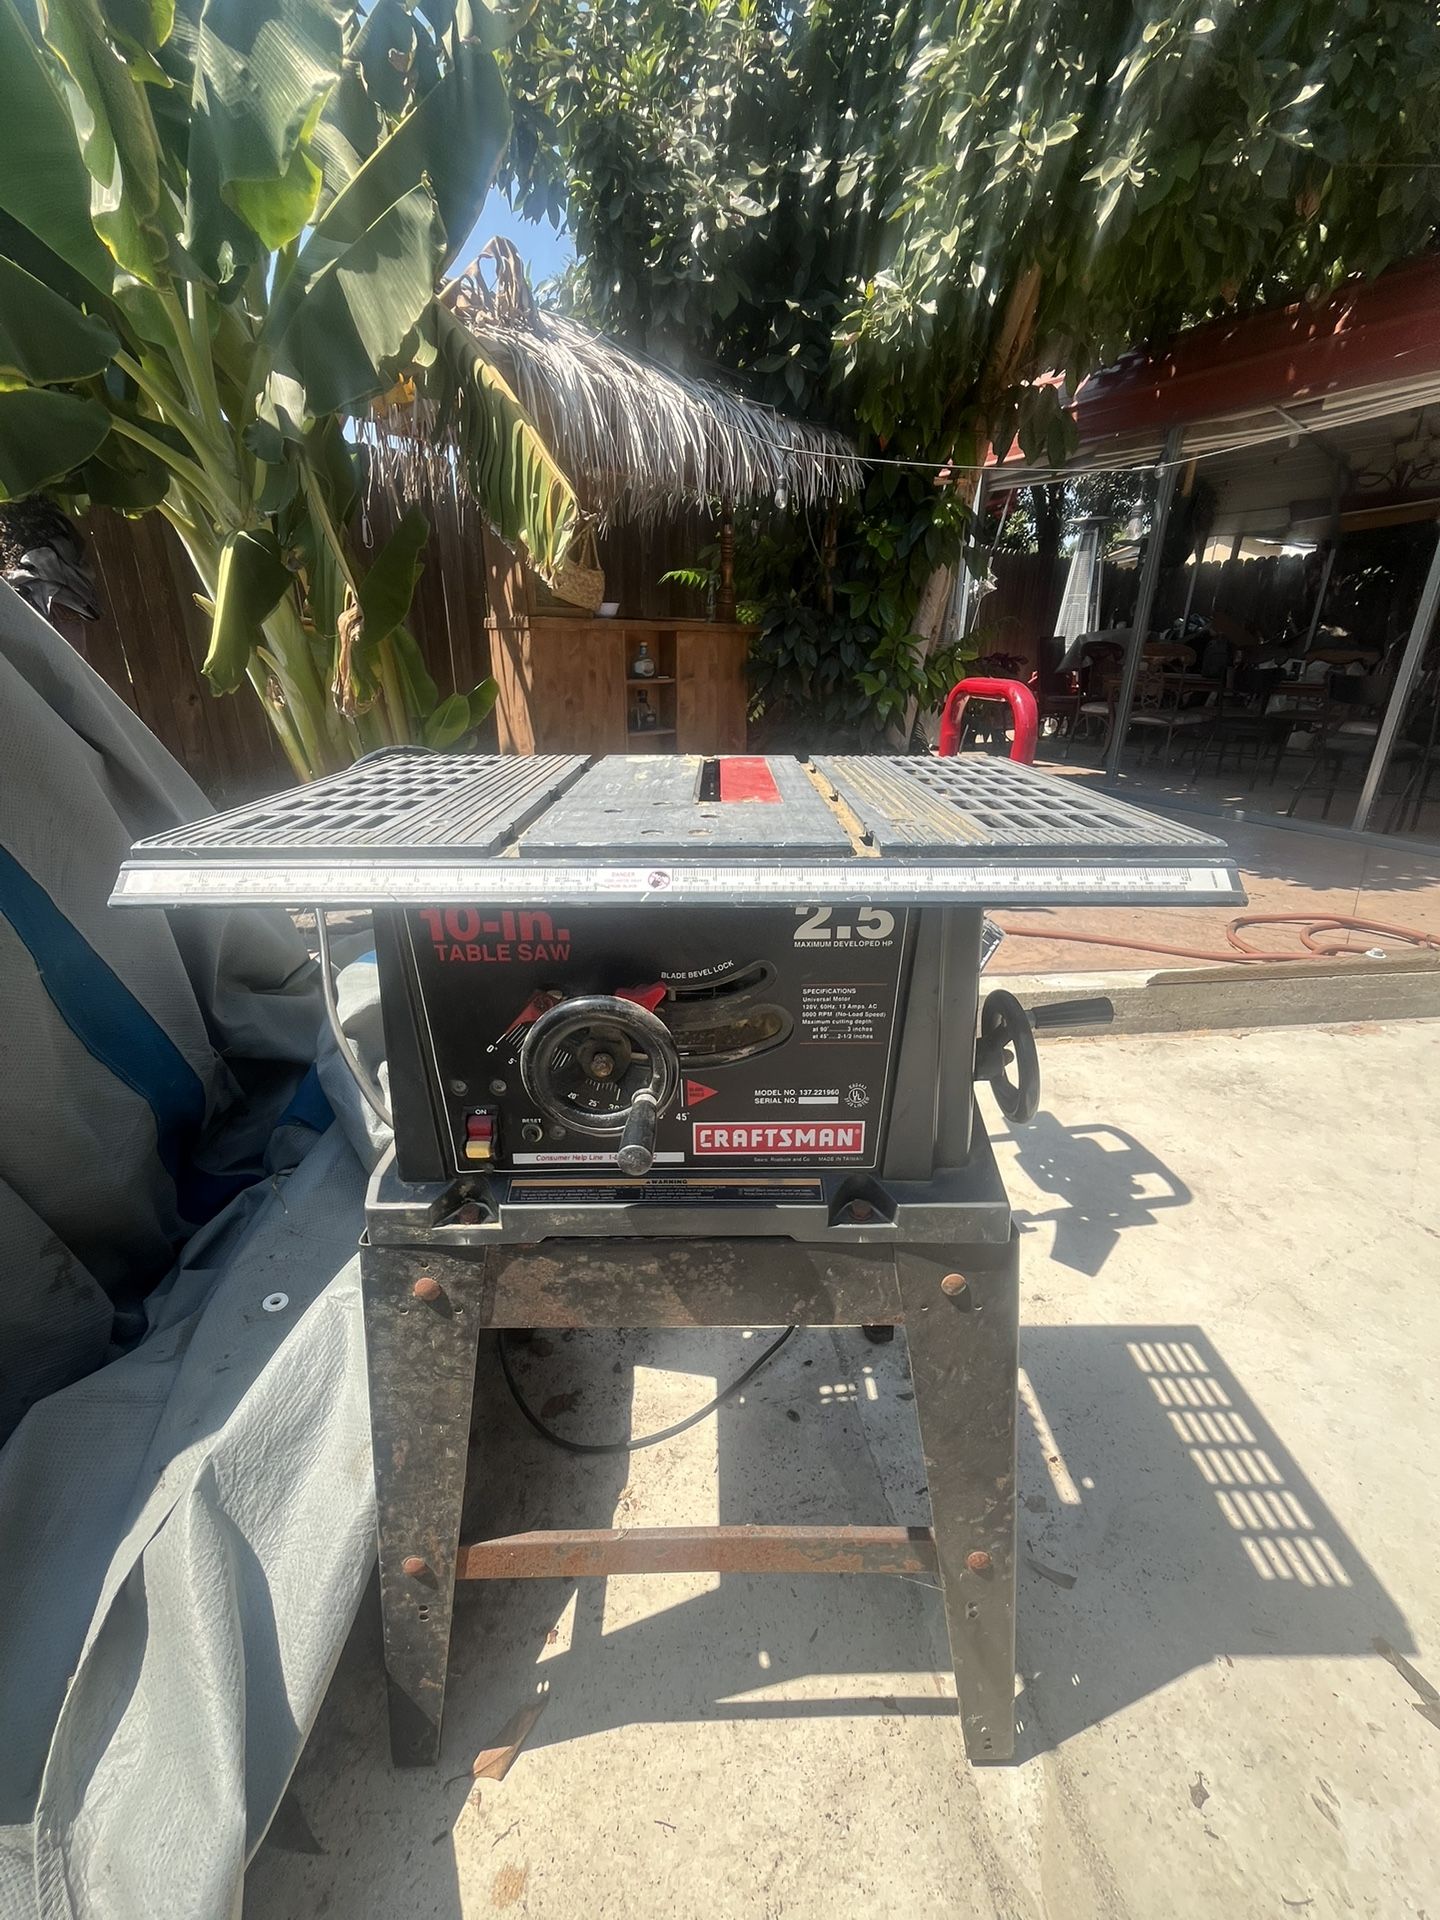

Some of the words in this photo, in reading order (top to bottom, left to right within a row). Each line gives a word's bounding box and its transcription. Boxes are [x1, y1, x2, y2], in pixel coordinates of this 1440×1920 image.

[419, 907, 570, 942] 10-in.
[793, 907, 895, 940] 2.5
[434, 944, 511, 962] TABLE
[517, 944, 571, 961] SAW
[688, 968, 713, 978] BEVEL
[713, 960, 734, 973] LOCK
[699, 1128, 853, 1148] CRAFTSMAN
[572, 1154, 587, 1162] Help
